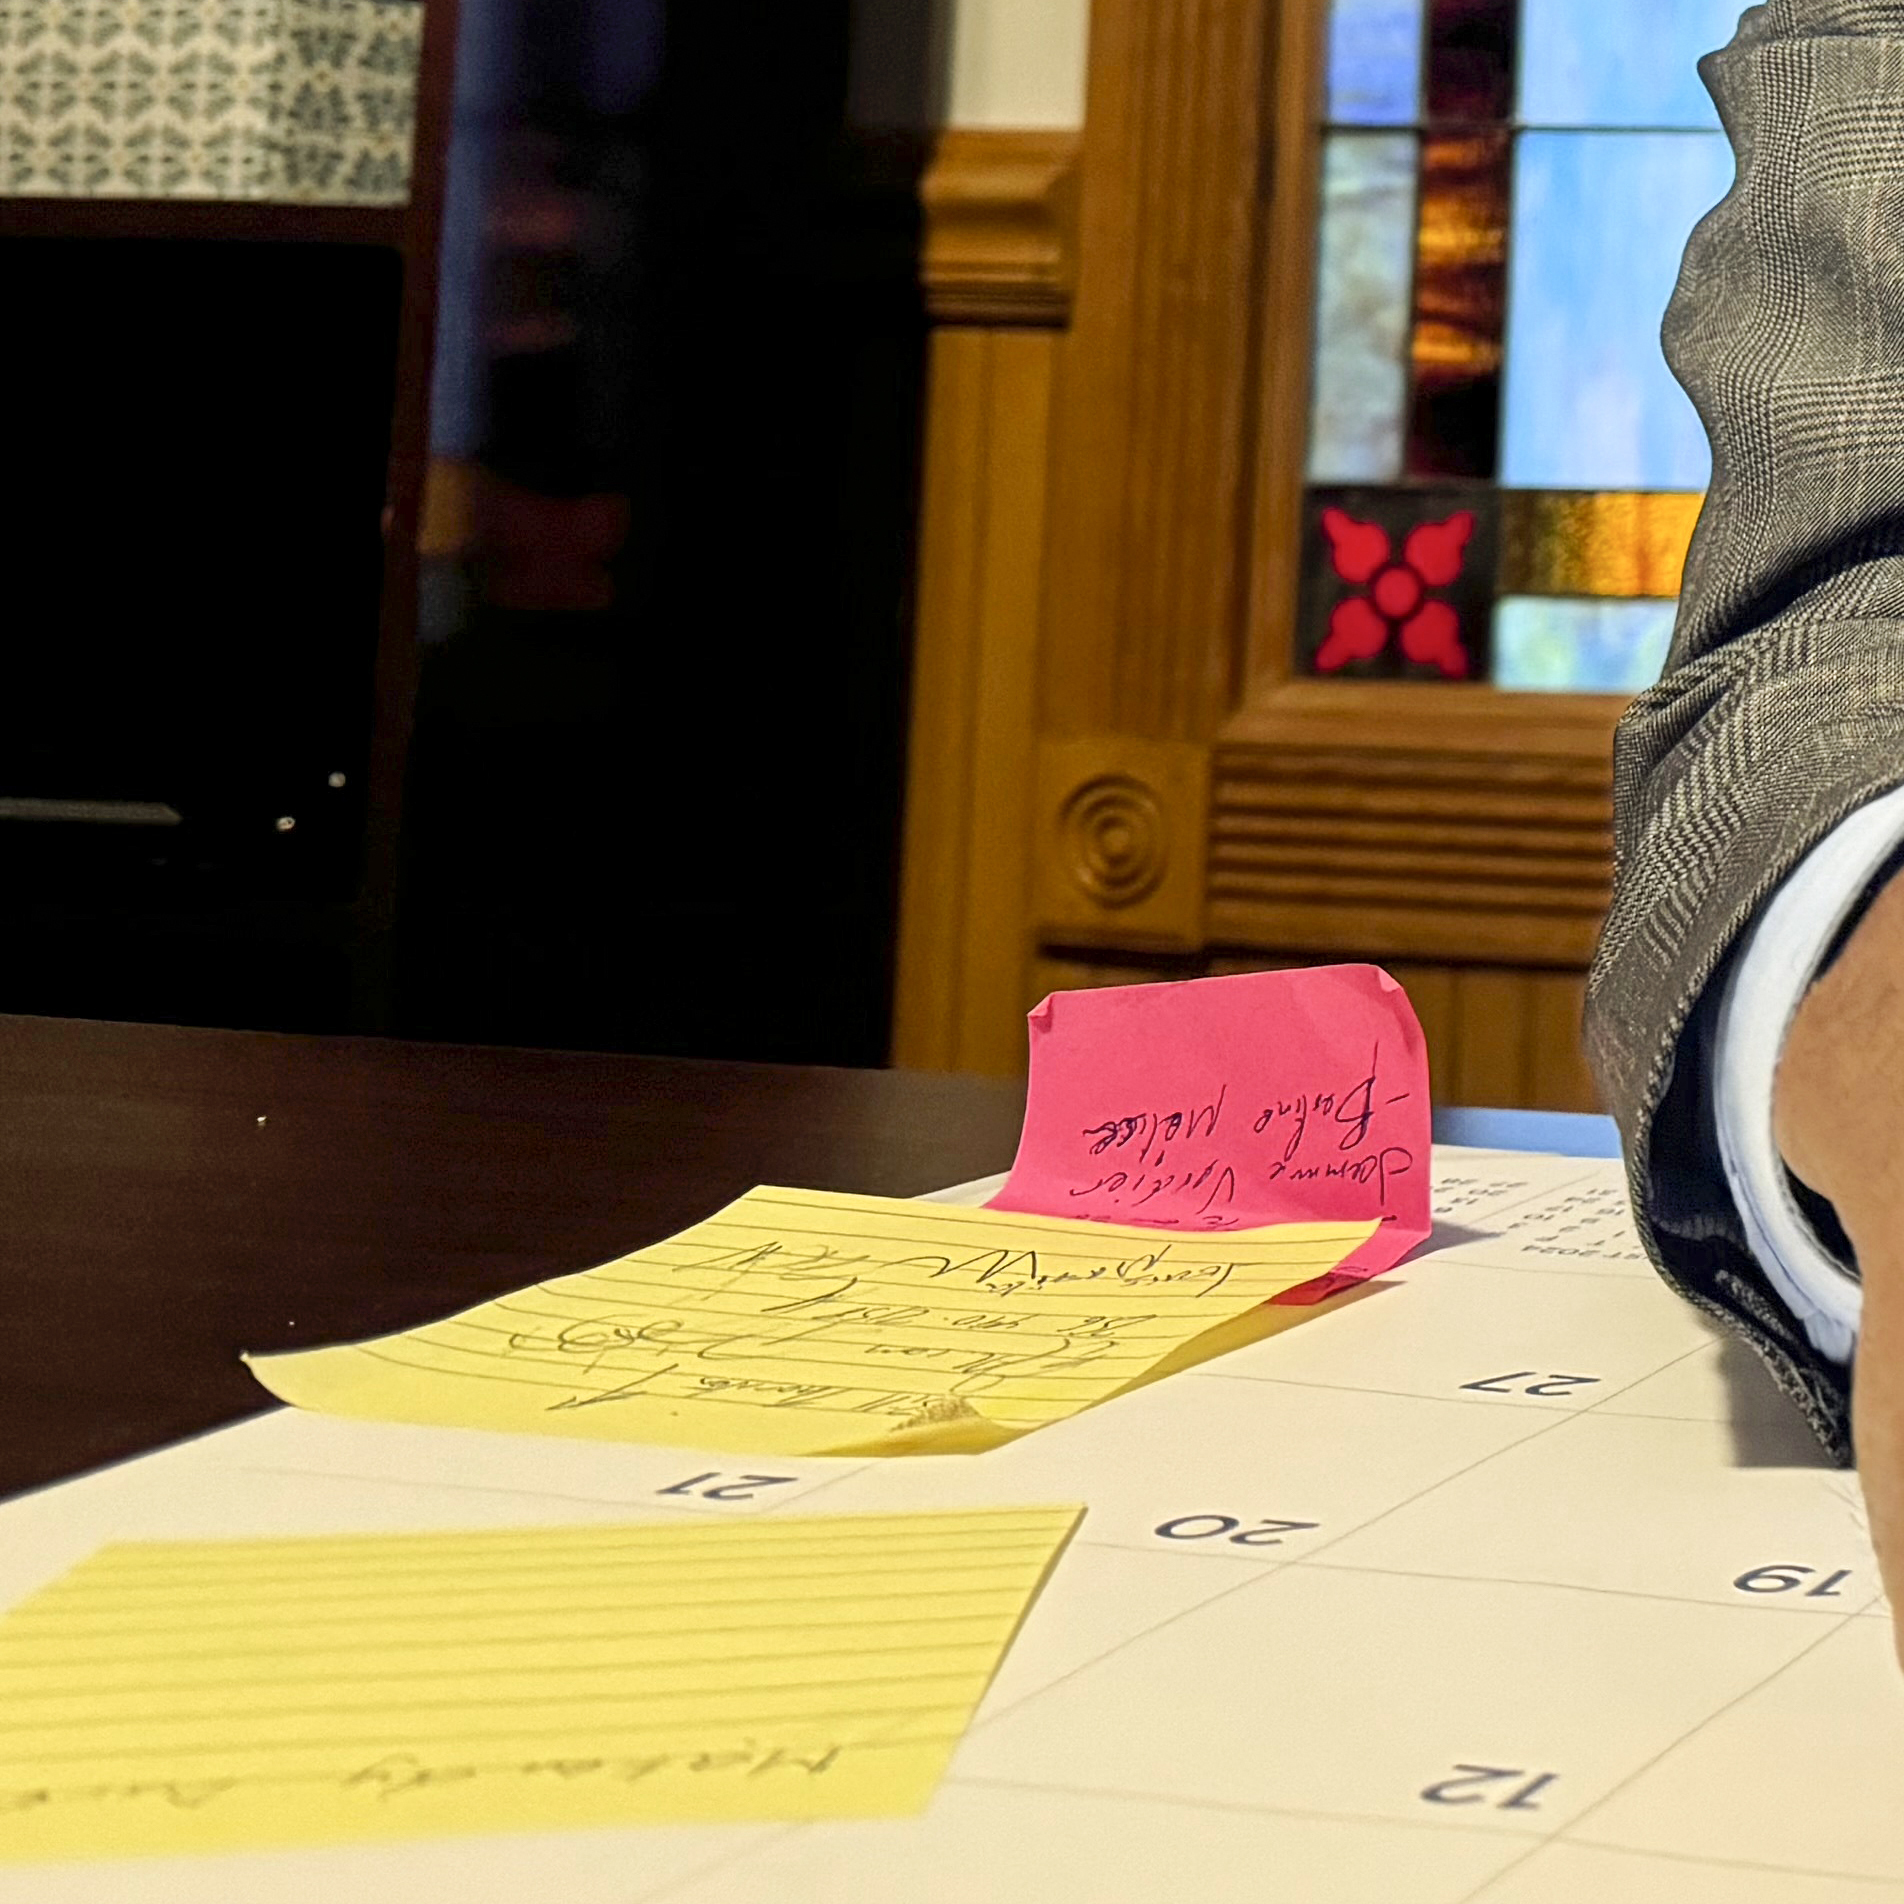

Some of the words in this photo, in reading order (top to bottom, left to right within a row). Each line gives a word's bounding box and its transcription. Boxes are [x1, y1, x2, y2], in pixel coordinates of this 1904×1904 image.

[1462, 1370, 1604, 1398] 27
[657, 1471, 798, 1500] 21
[1153, 1513, 1320, 1547] 20
[1732, 1564, 1854, 1597] 19
[1420, 1764, 1561, 1814] 12
